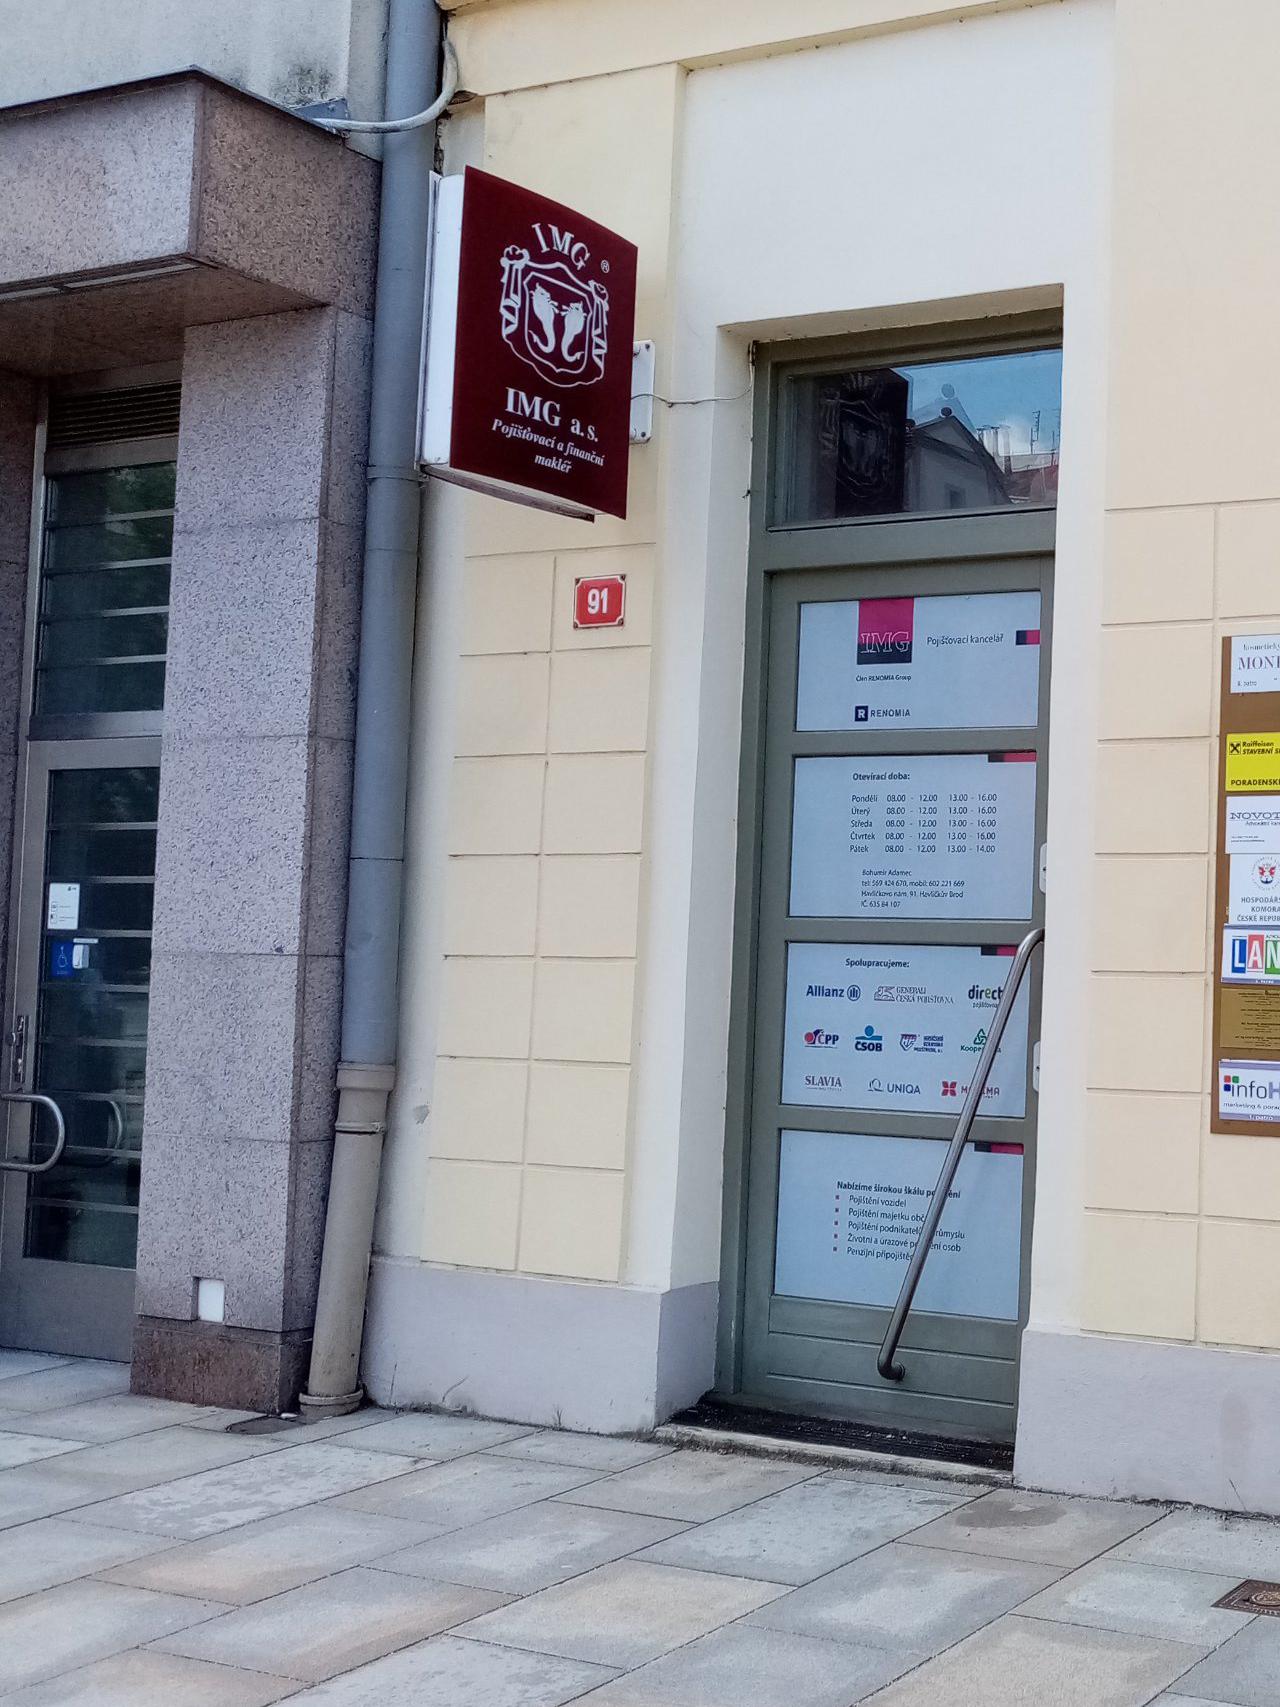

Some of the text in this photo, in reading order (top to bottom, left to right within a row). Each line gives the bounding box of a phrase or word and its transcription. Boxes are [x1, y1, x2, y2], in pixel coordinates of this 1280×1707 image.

[531, 223, 591, 271] IMG
[505, 386, 562, 428] IMG
[492, 418, 606, 467] Pojišťovací a finanční
[534, 454, 573, 474] makléř
[587, 587, 609, 615] 91
[860, 631, 911, 654] IMG
[870, 708, 911, 718] RENOMIA
[1242, 747, 1274, 755] STAVEBNÍ
[888, 771, 910, 780] doba:
[919, 794, 938, 802] 12.00
[919, 807, 938, 815] 12.00
[918, 819, 937, 828] 12.00
[918, 832, 937, 840] 12.00
[917, 845, 936, 853] 12.00
[1237, 913, 1258, 922] ČESKÉ
[845, 958, 910, 969] Spolupracujeme:
[806, 984, 845, 998] Allianz
[855, 1041, 883, 1052] ČSOB
[804, 1075, 842, 1088] SLAVIA
[887, 1083, 921, 1095] UNIQA
[837, 1181, 872, 1192] Nabízíme
[873, 1184, 903, 1194] širokou
